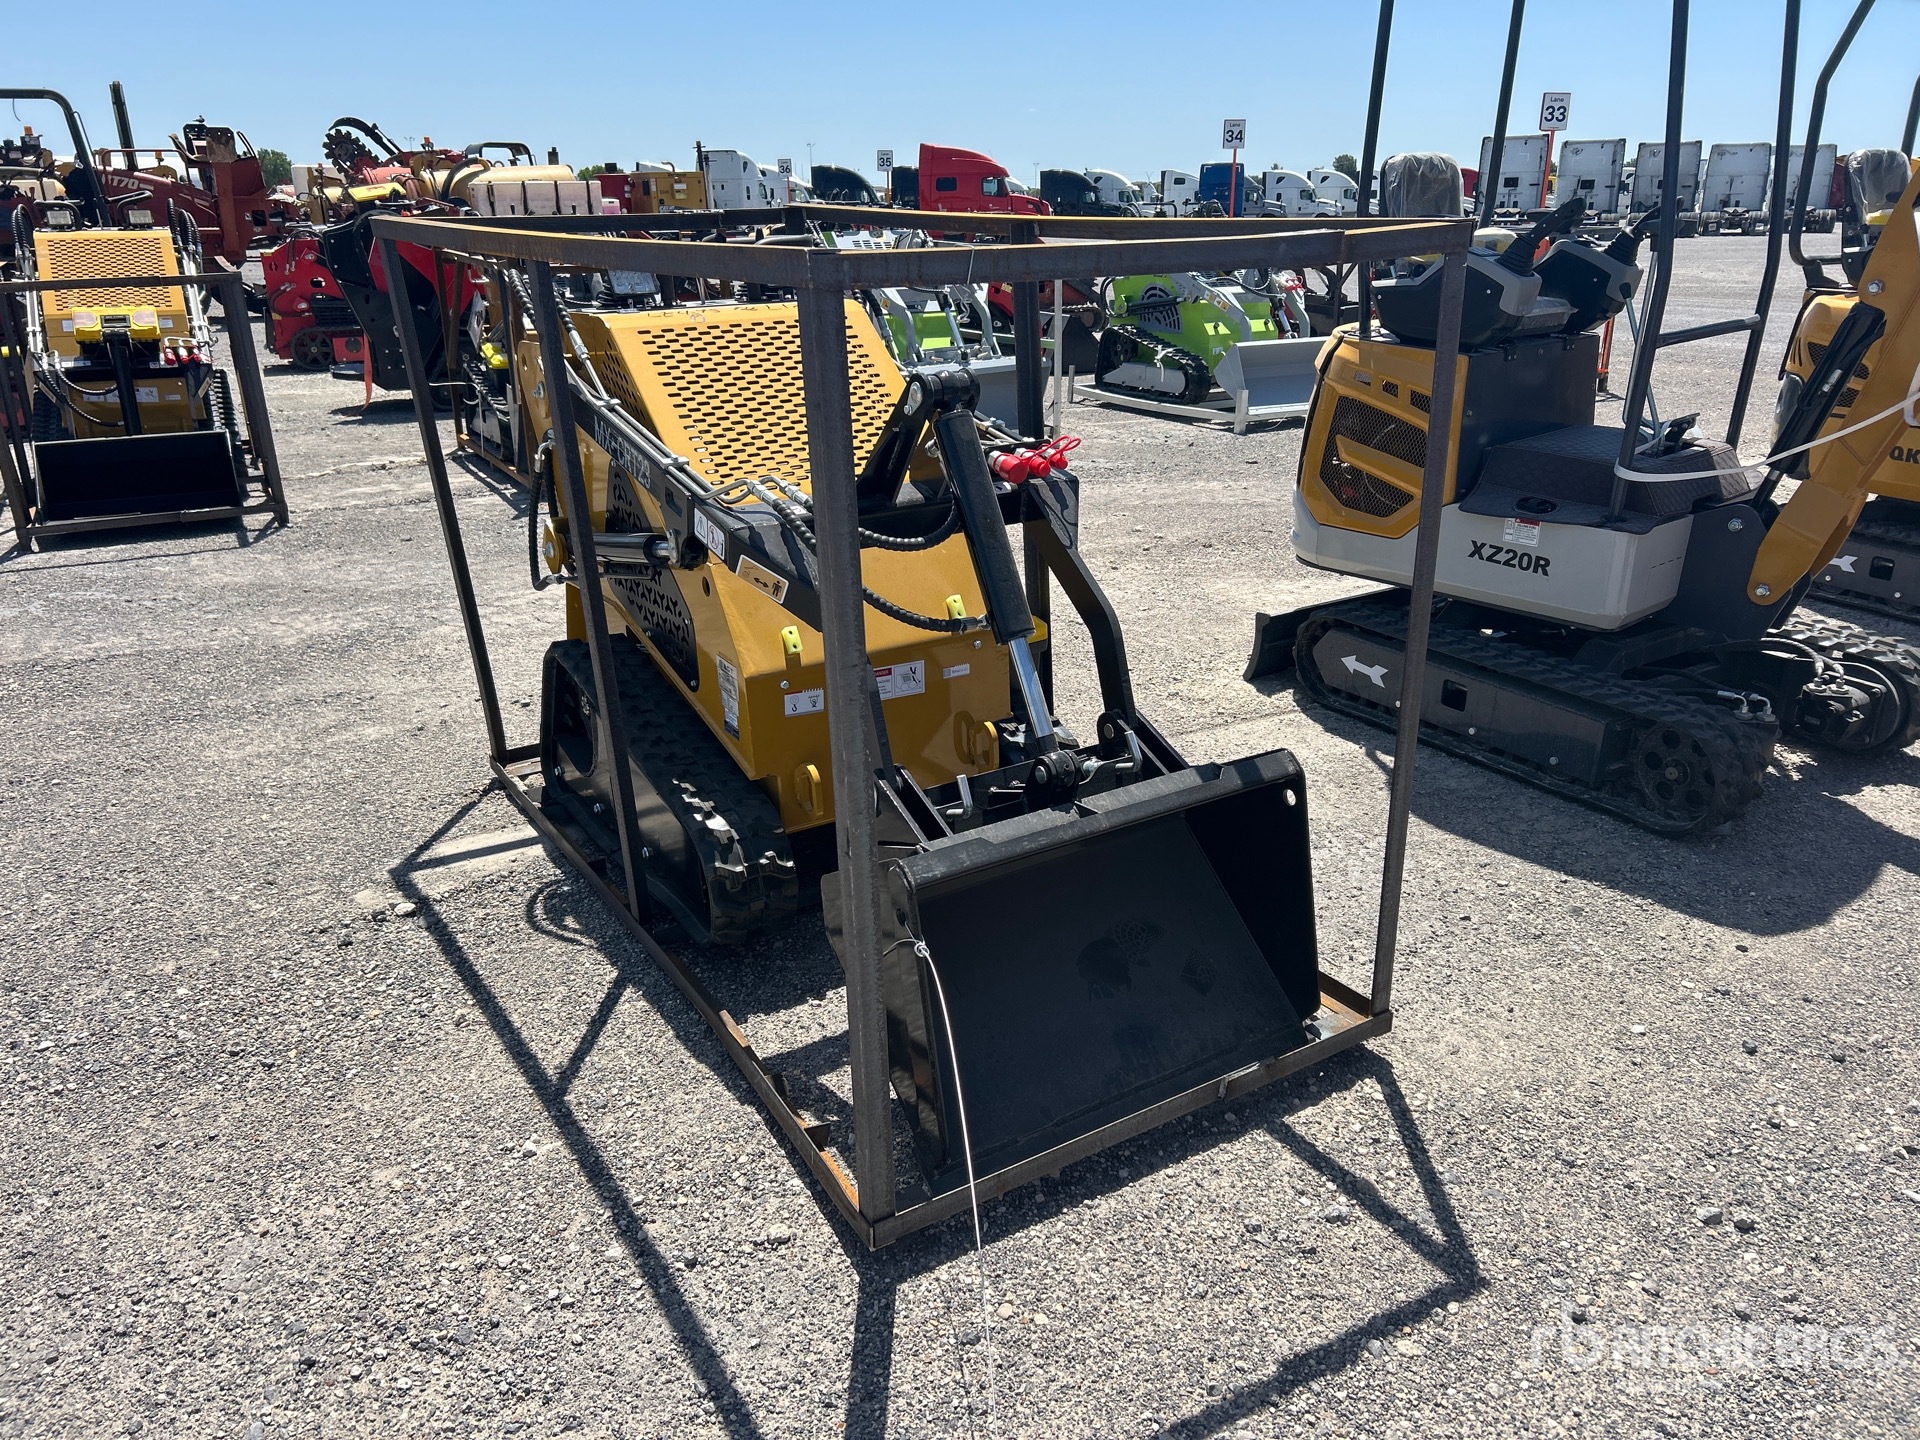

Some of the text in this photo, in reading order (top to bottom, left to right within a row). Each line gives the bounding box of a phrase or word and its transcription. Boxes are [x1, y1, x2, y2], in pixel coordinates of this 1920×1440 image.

[1544, 105, 1567, 122] 33
[1225, 129, 1243, 143] 34
[878, 157, 892, 167] 35
[779, 165, 791, 174] 36
[1467, 539, 1551, 577] XZ20R
